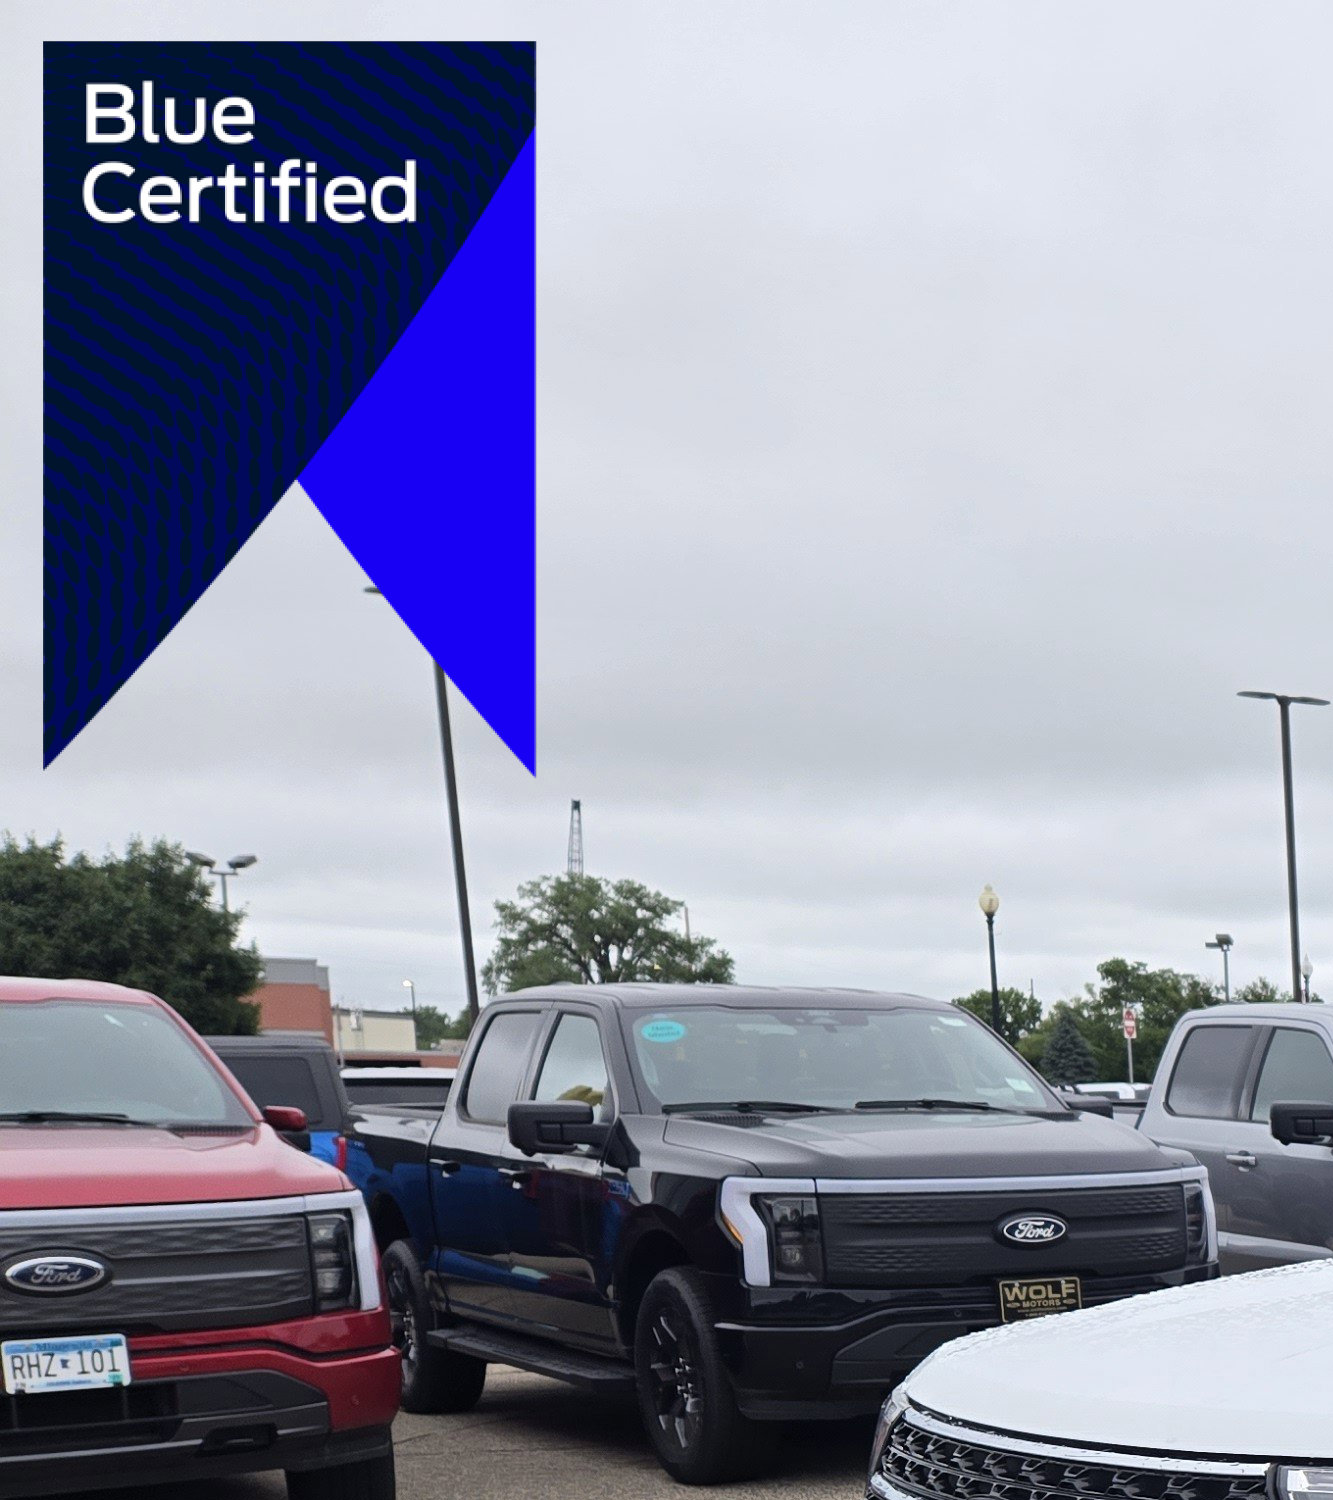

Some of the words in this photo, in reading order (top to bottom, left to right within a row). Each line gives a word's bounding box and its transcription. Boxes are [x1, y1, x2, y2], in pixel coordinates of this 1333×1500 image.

[1015, 1221, 1055, 1238] Ford
[30, 1263, 82, 1284] Ford
[1004, 1283, 1076, 1300] WOLF
[1022, 1299, 1061, 1308] MOTORS
[10, 1352, 57, 1380] RHZ
[77, 1348, 121, 1375] 101
